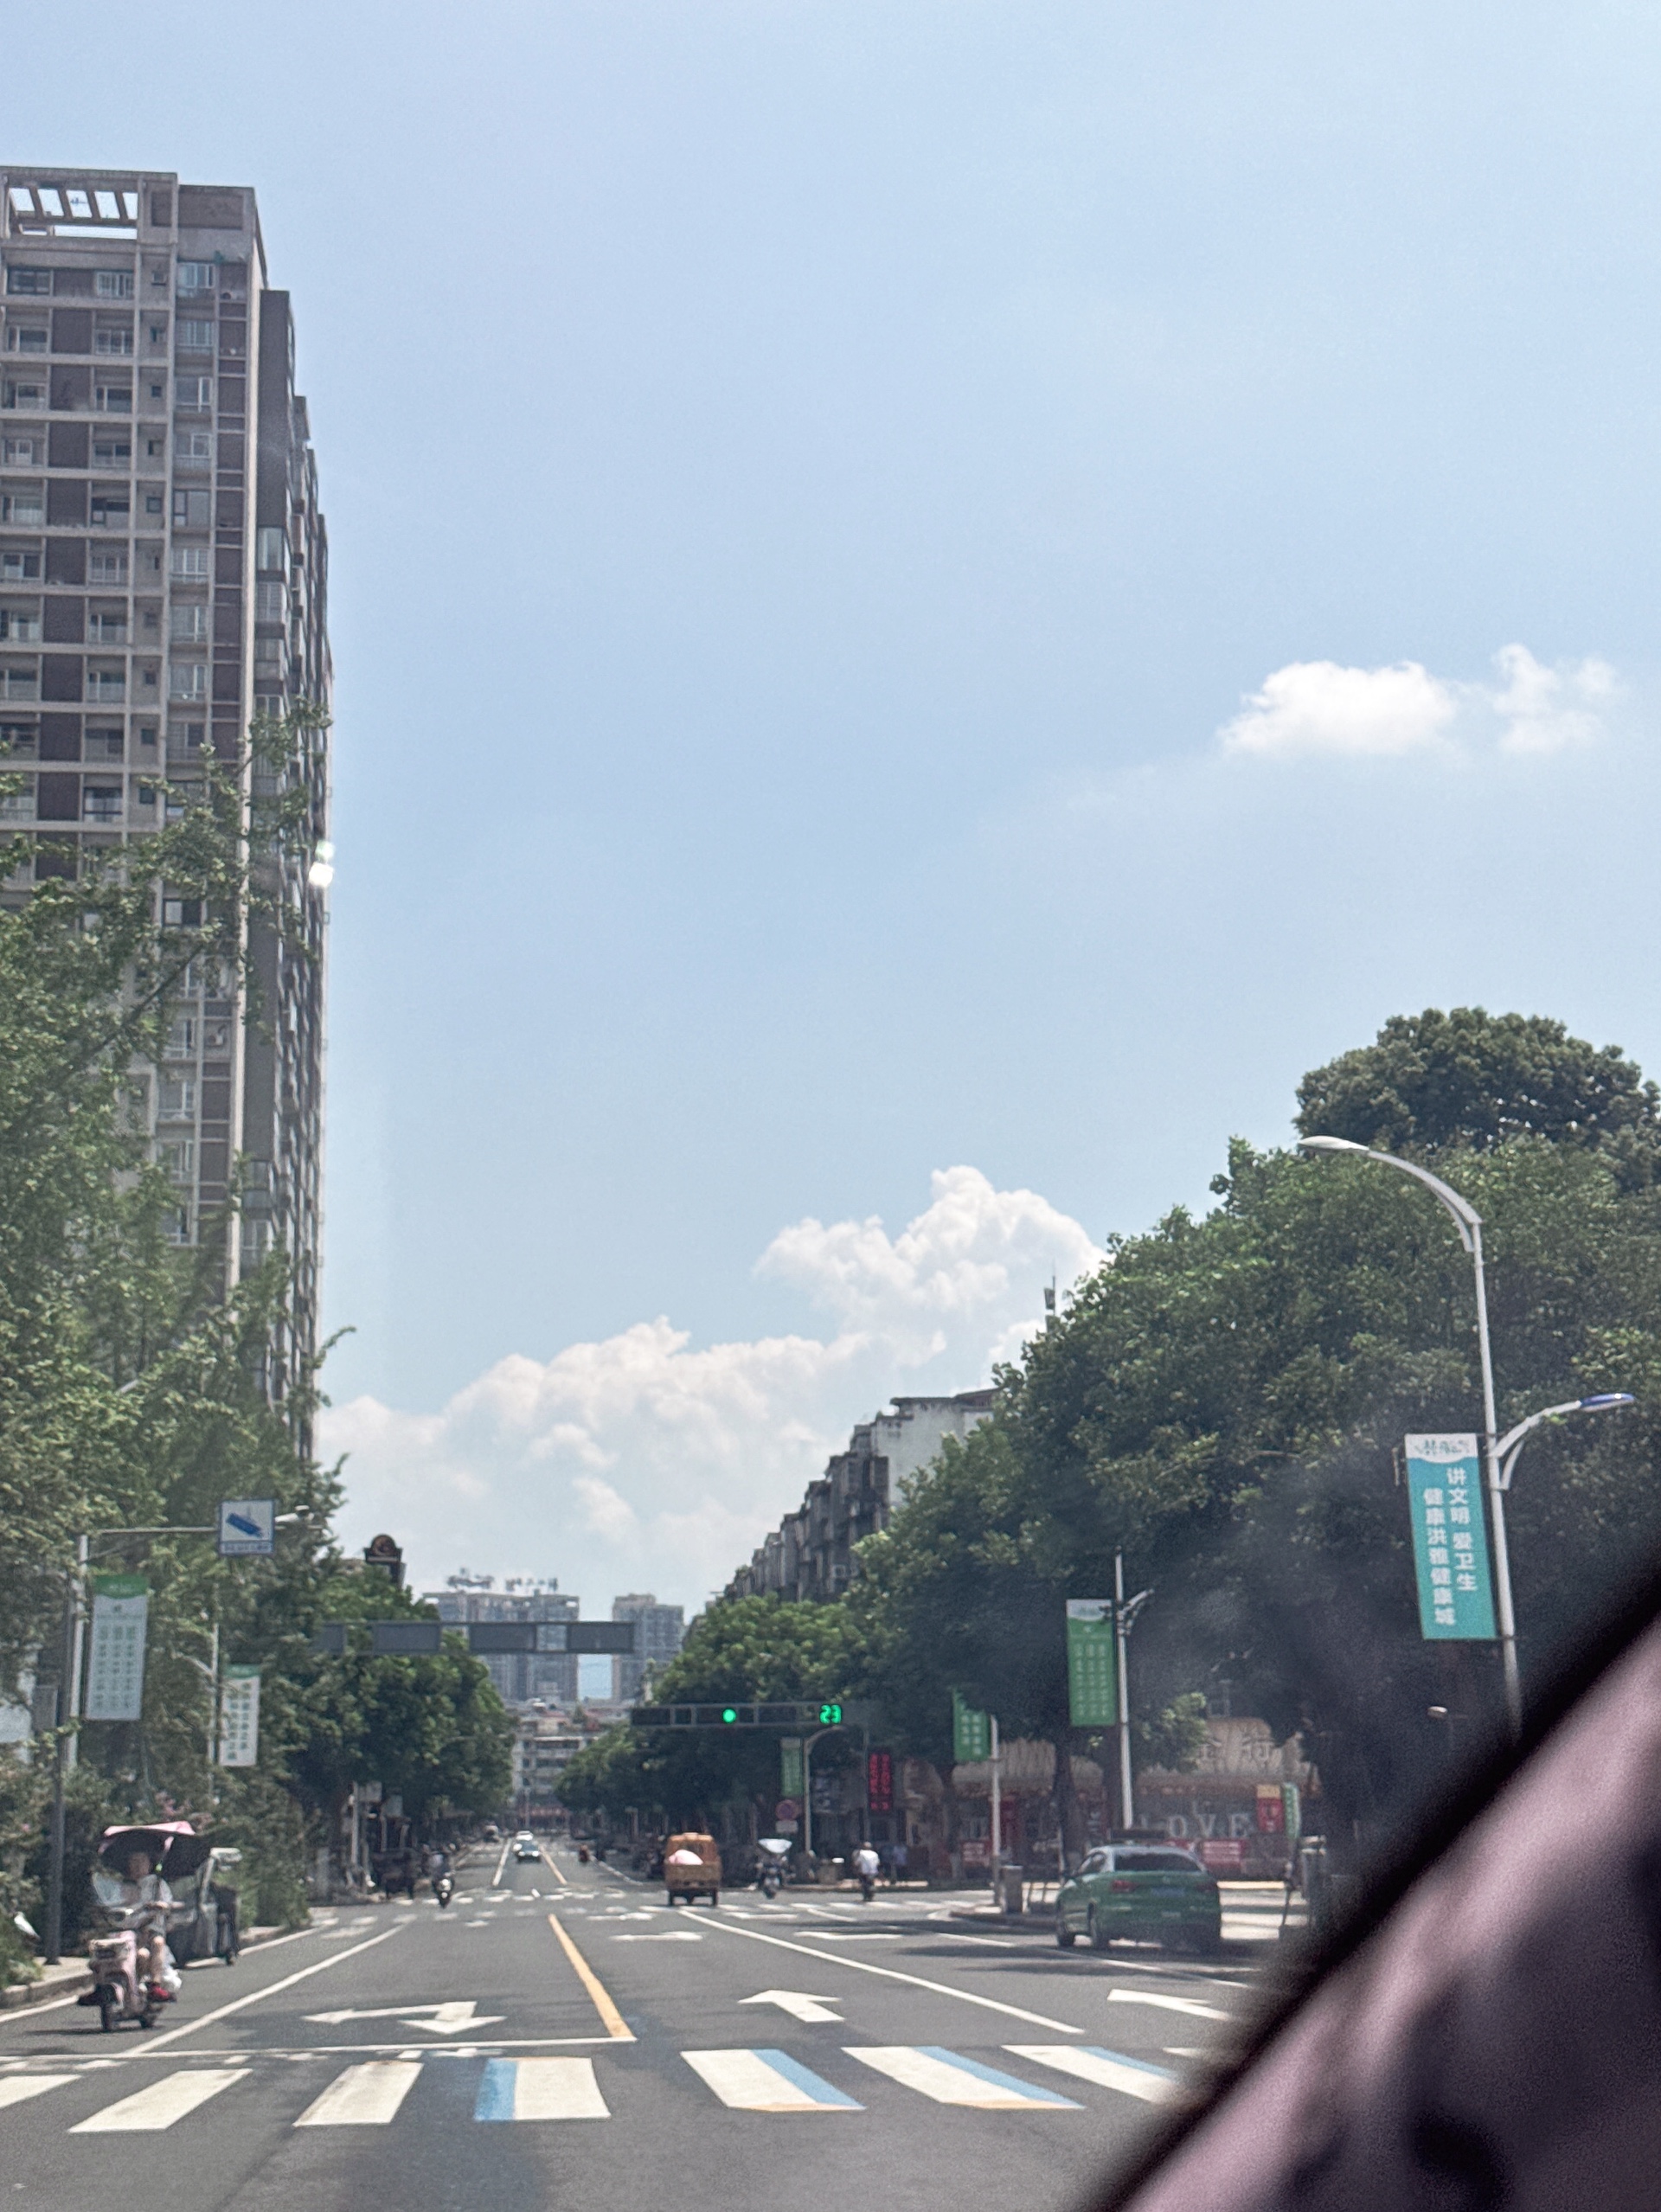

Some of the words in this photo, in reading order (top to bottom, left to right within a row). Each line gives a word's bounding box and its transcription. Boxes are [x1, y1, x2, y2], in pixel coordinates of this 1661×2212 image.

[1446, 1467, 1470, 1524] 讲文明
[1423, 1487, 1455, 1625] 健康洪雅健康城
[1453, 1531, 1478, 1591] 爱卫生
[819, 1704, 842, 1724] 23
